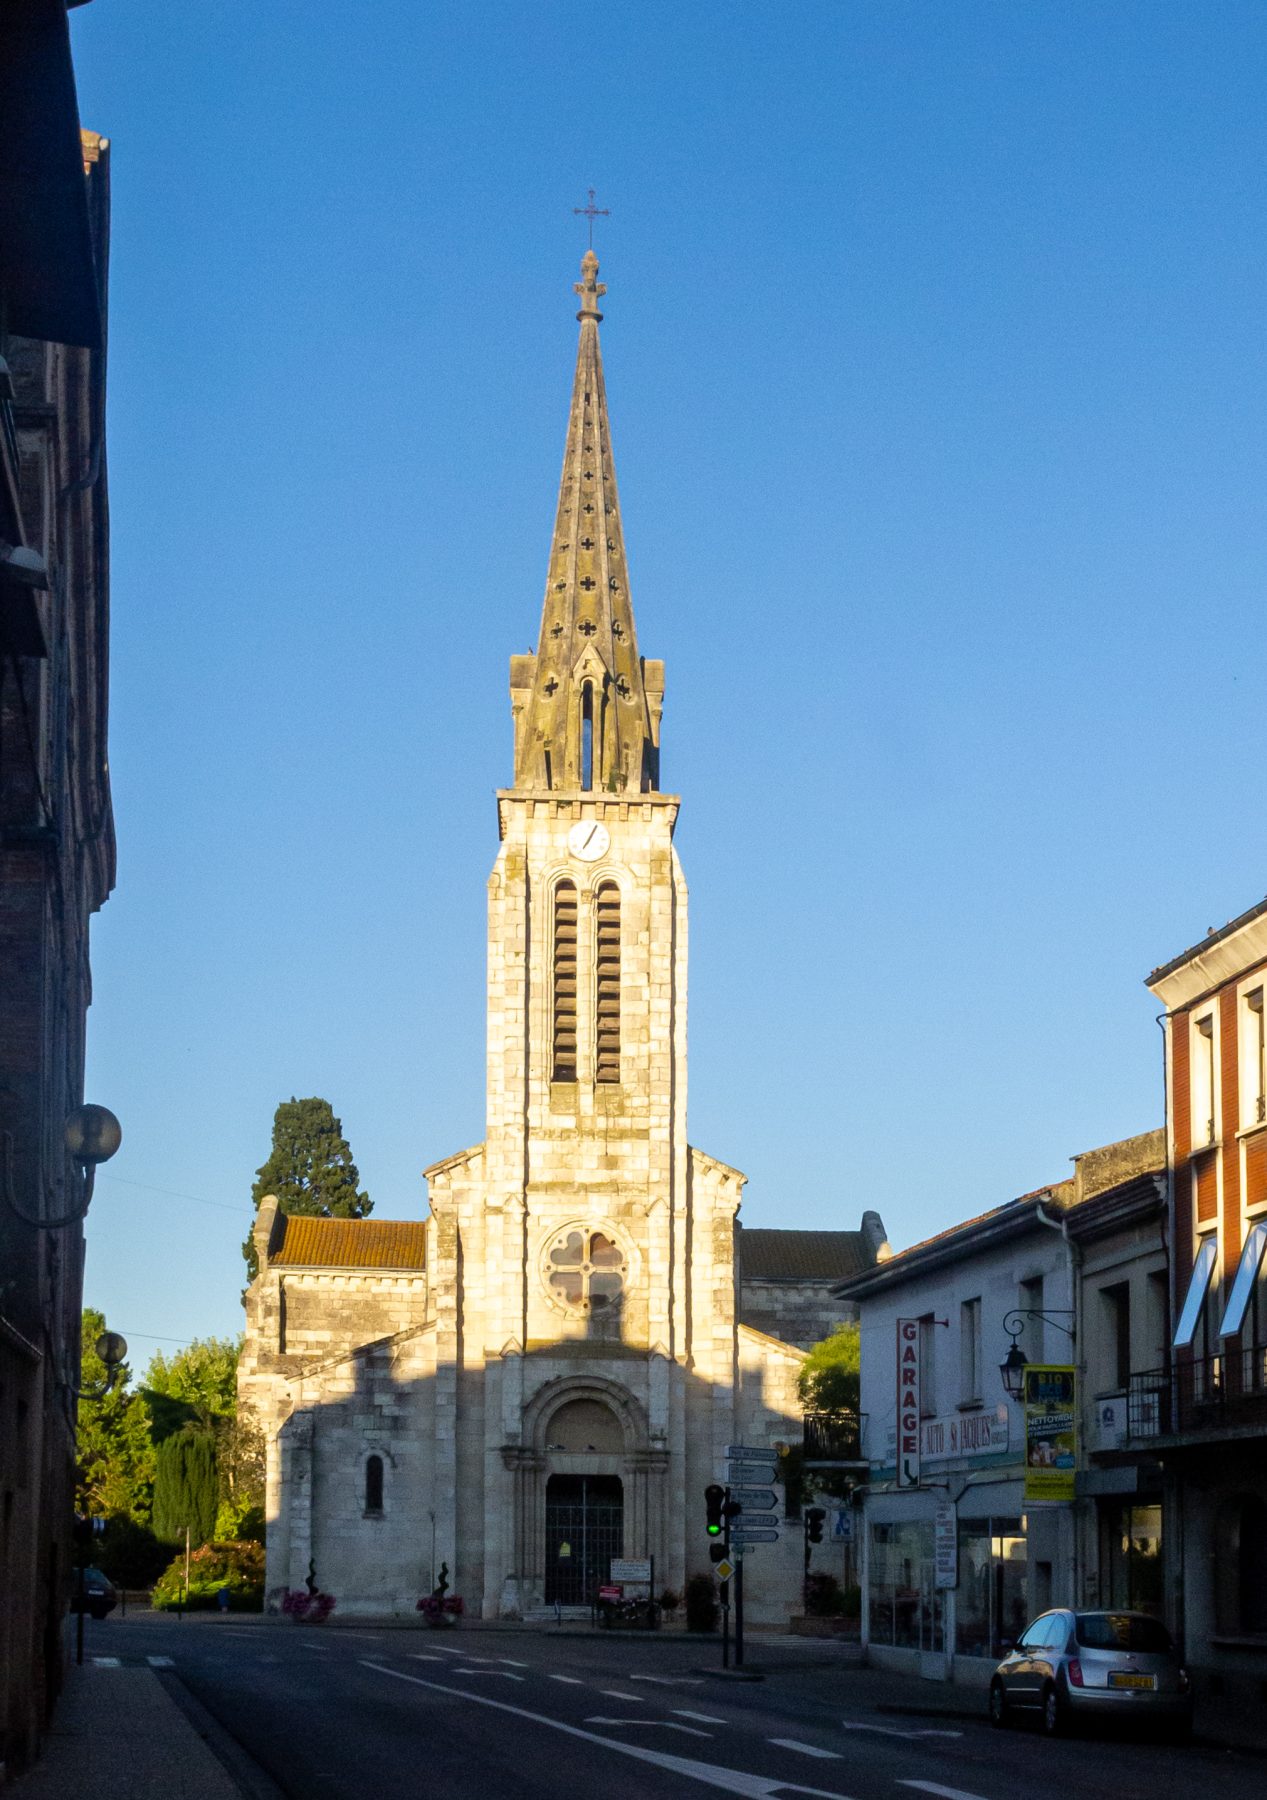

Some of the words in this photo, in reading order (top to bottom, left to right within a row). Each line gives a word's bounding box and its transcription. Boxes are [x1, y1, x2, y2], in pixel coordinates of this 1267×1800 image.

[903, 1323, 917, 1453] GARAGE
[1028, 1413, 1073, 1425] NETTOYAGE
[927, 1422, 944, 1455] AUTO
